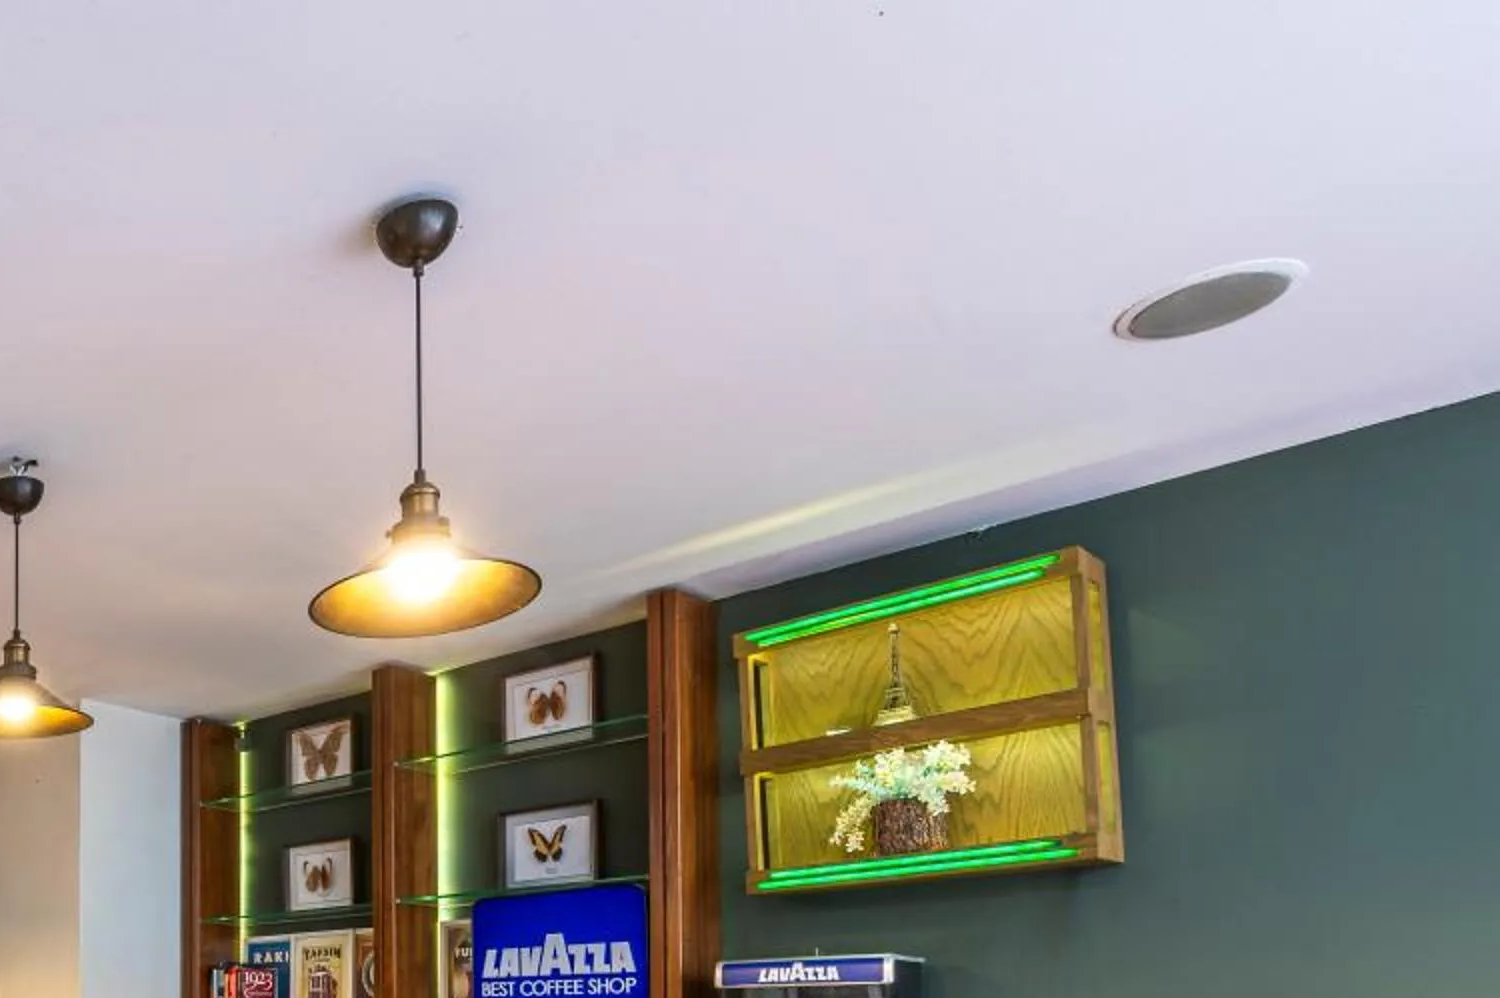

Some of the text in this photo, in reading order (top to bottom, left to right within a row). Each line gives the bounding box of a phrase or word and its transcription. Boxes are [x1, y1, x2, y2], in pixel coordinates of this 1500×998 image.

[481, 933, 637, 979] LAVAZZA
[244, 971, 273, 990] 1923
[757, 962, 841, 982] LAVAZZA
[481, 977, 637, 997] BEST COFFEE SHOP
